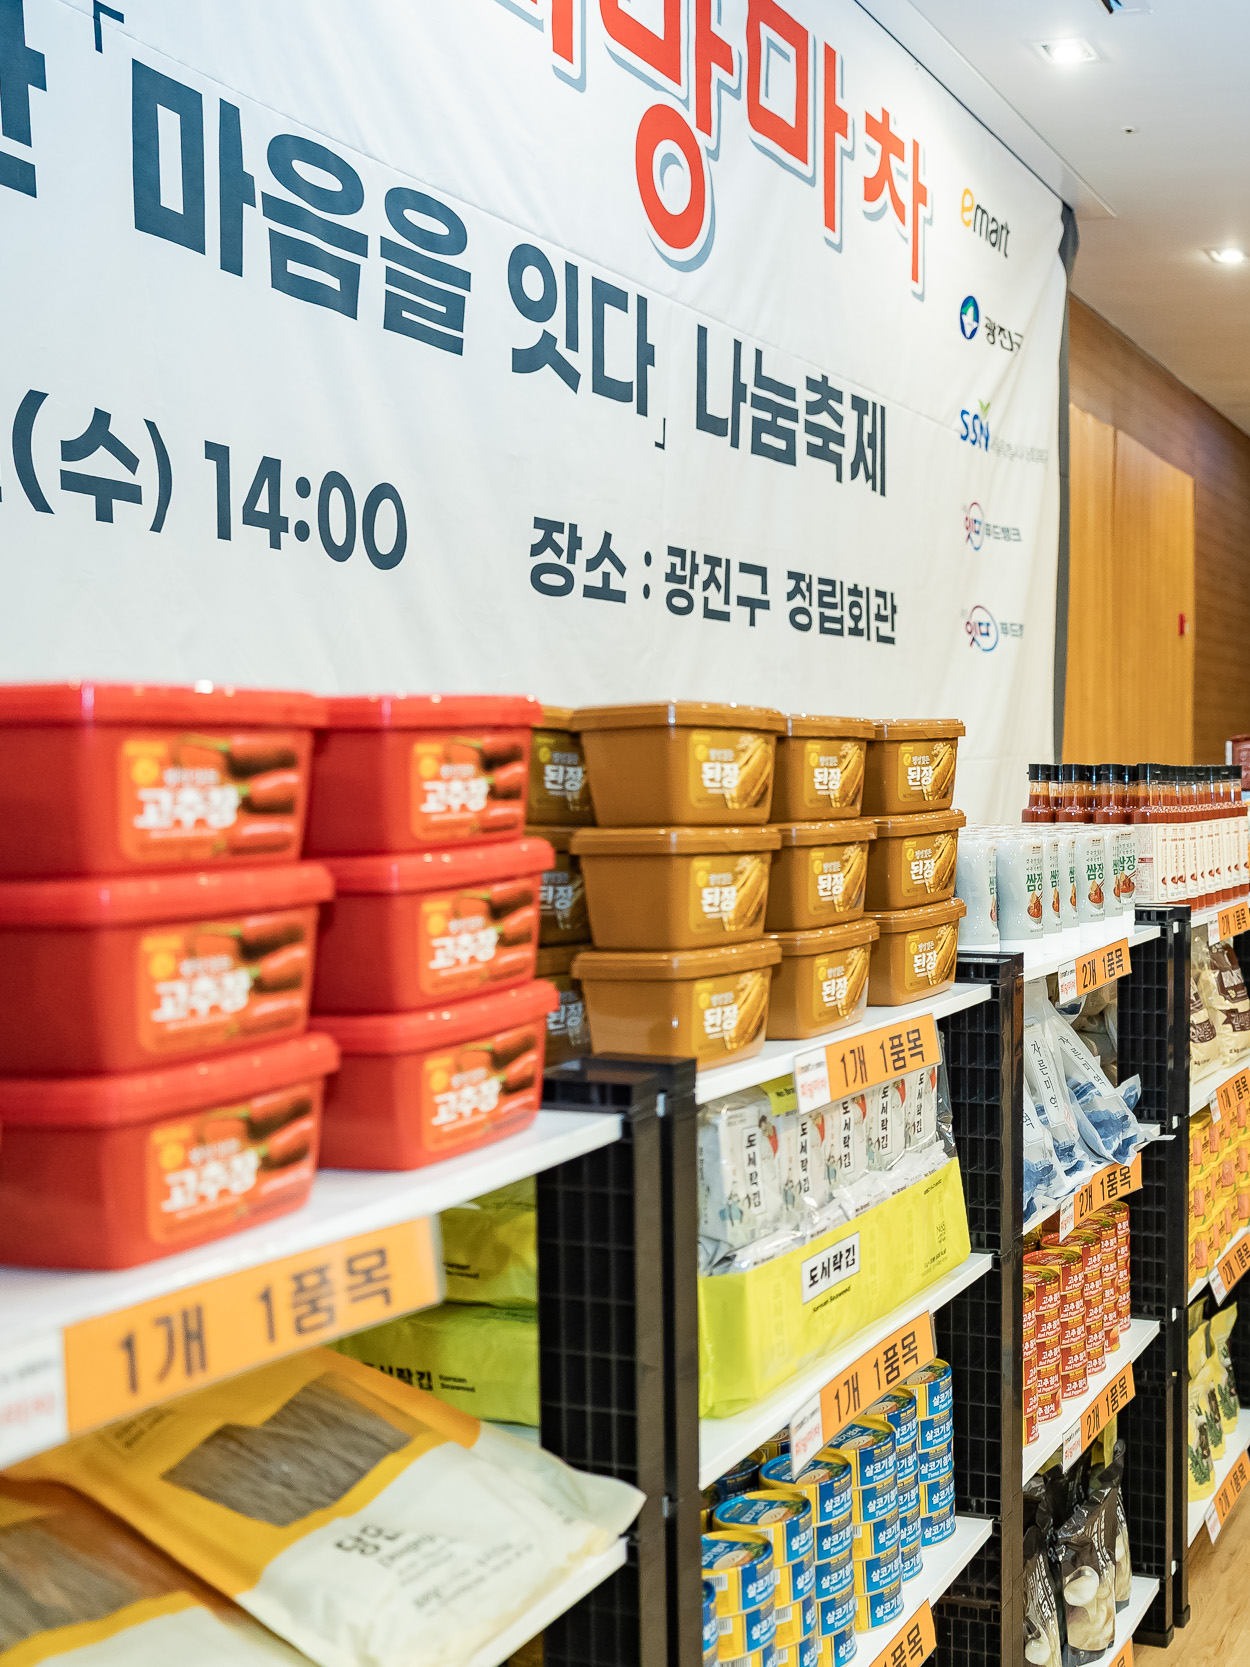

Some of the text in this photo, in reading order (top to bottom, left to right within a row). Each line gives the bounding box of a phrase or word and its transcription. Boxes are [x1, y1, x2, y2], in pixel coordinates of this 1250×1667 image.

[534, 0, 928, 284] 망마차
[961, 188, 1010, 258] emart
[696, 323, 888, 497] 나눔축제
[960, 409, 990, 452] SSN
[204, 439, 408, 570] 14:00
[529, 515, 628, 604] 장소
[664, 544, 770, 627] 광진구
[785, 569, 898, 645] 정립회관
[420, 777, 490, 813] 고추장
[544, 764, 584, 792] 된장
[701, 762, 740, 789] 된장
[813, 767, 842, 790] 된장
[907, 766, 934, 786] 된장
[817, 872, 845, 897] 된장
[910, 858, 935, 880] 된장
[1086, 863, 1104, 881] 쌈장
[701, 886, 737, 913] 된장
[1233, 908, 1248, 931] 1품목
[428, 927, 500, 970] 고추장
[912, 950, 937, 974] 된장
[1082, 947, 1125, 989] 2개 1품목
[822, 976, 849, 1003] 된장
[704, 1004, 739, 1034] 된장
[840, 1028, 925, 1088] 1개 1품목
[431, 1077, 501, 1127] 고추장
[1232, 1075, 1250, 1102] 1품목
[1079, 1166, 1132, 1218] 2개 1품목
[808, 1244, 856, 1289] 도시락김
[119, 1247, 393, 1395] 1개 1품목
[834, 1330, 919, 1424] 1개 1품목
[1086, 1375, 1128, 1442] 2개 1품목
[920, 1451, 953, 1475] 살코기참치
[878, 1519, 900, 1544] 살코기
[884, 1622, 924, 1667] 품목
